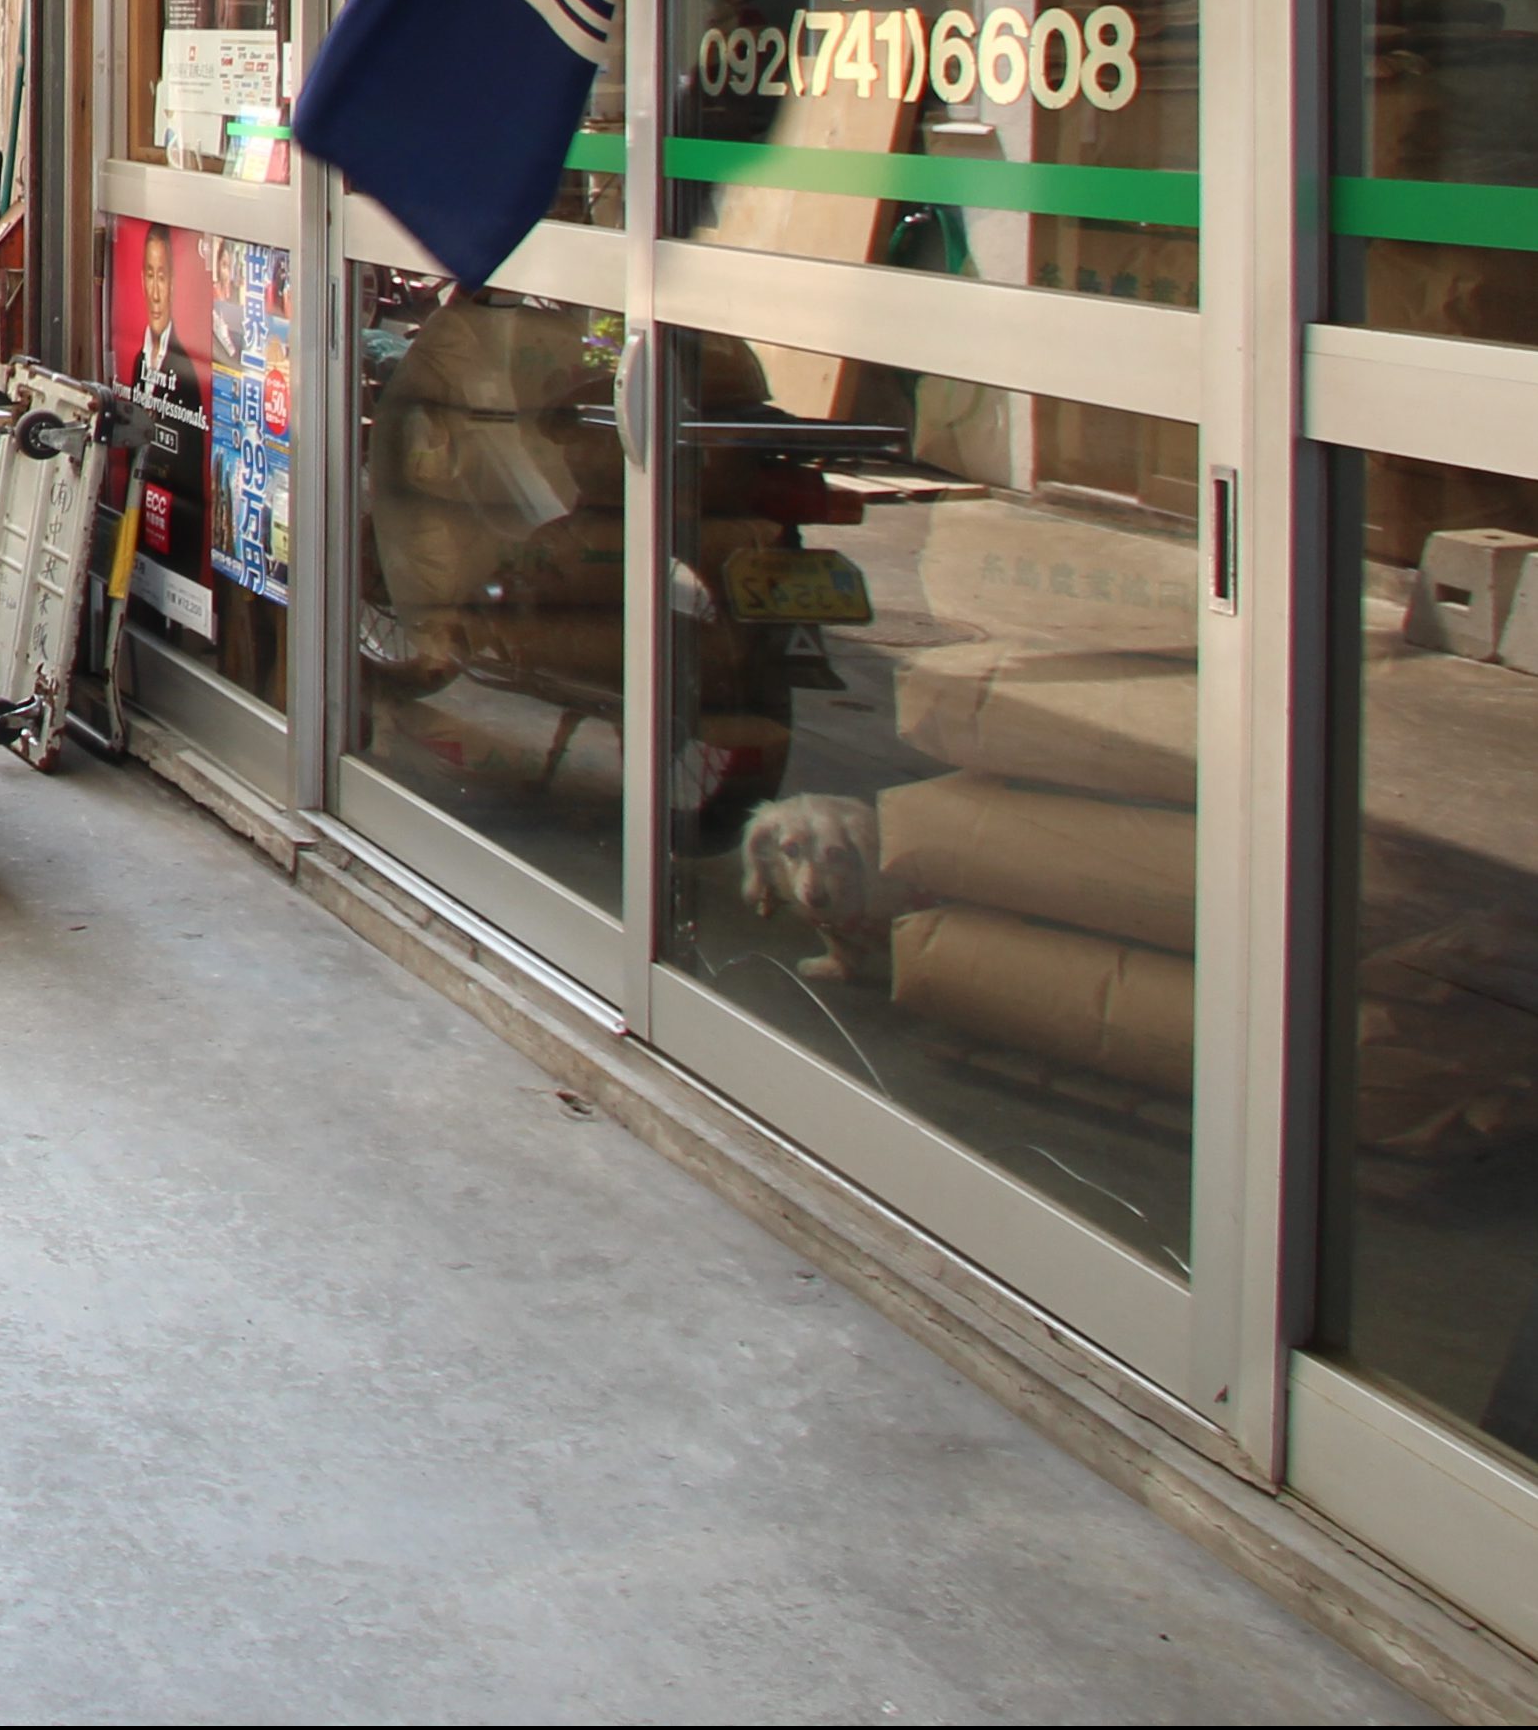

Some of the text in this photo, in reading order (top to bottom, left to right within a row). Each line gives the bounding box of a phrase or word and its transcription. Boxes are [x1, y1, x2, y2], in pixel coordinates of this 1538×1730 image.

[699, 5, 1137, 111] 092(741)6608
[140, 360, 177, 392] Learn it
[145, 489, 167, 514] ECC
